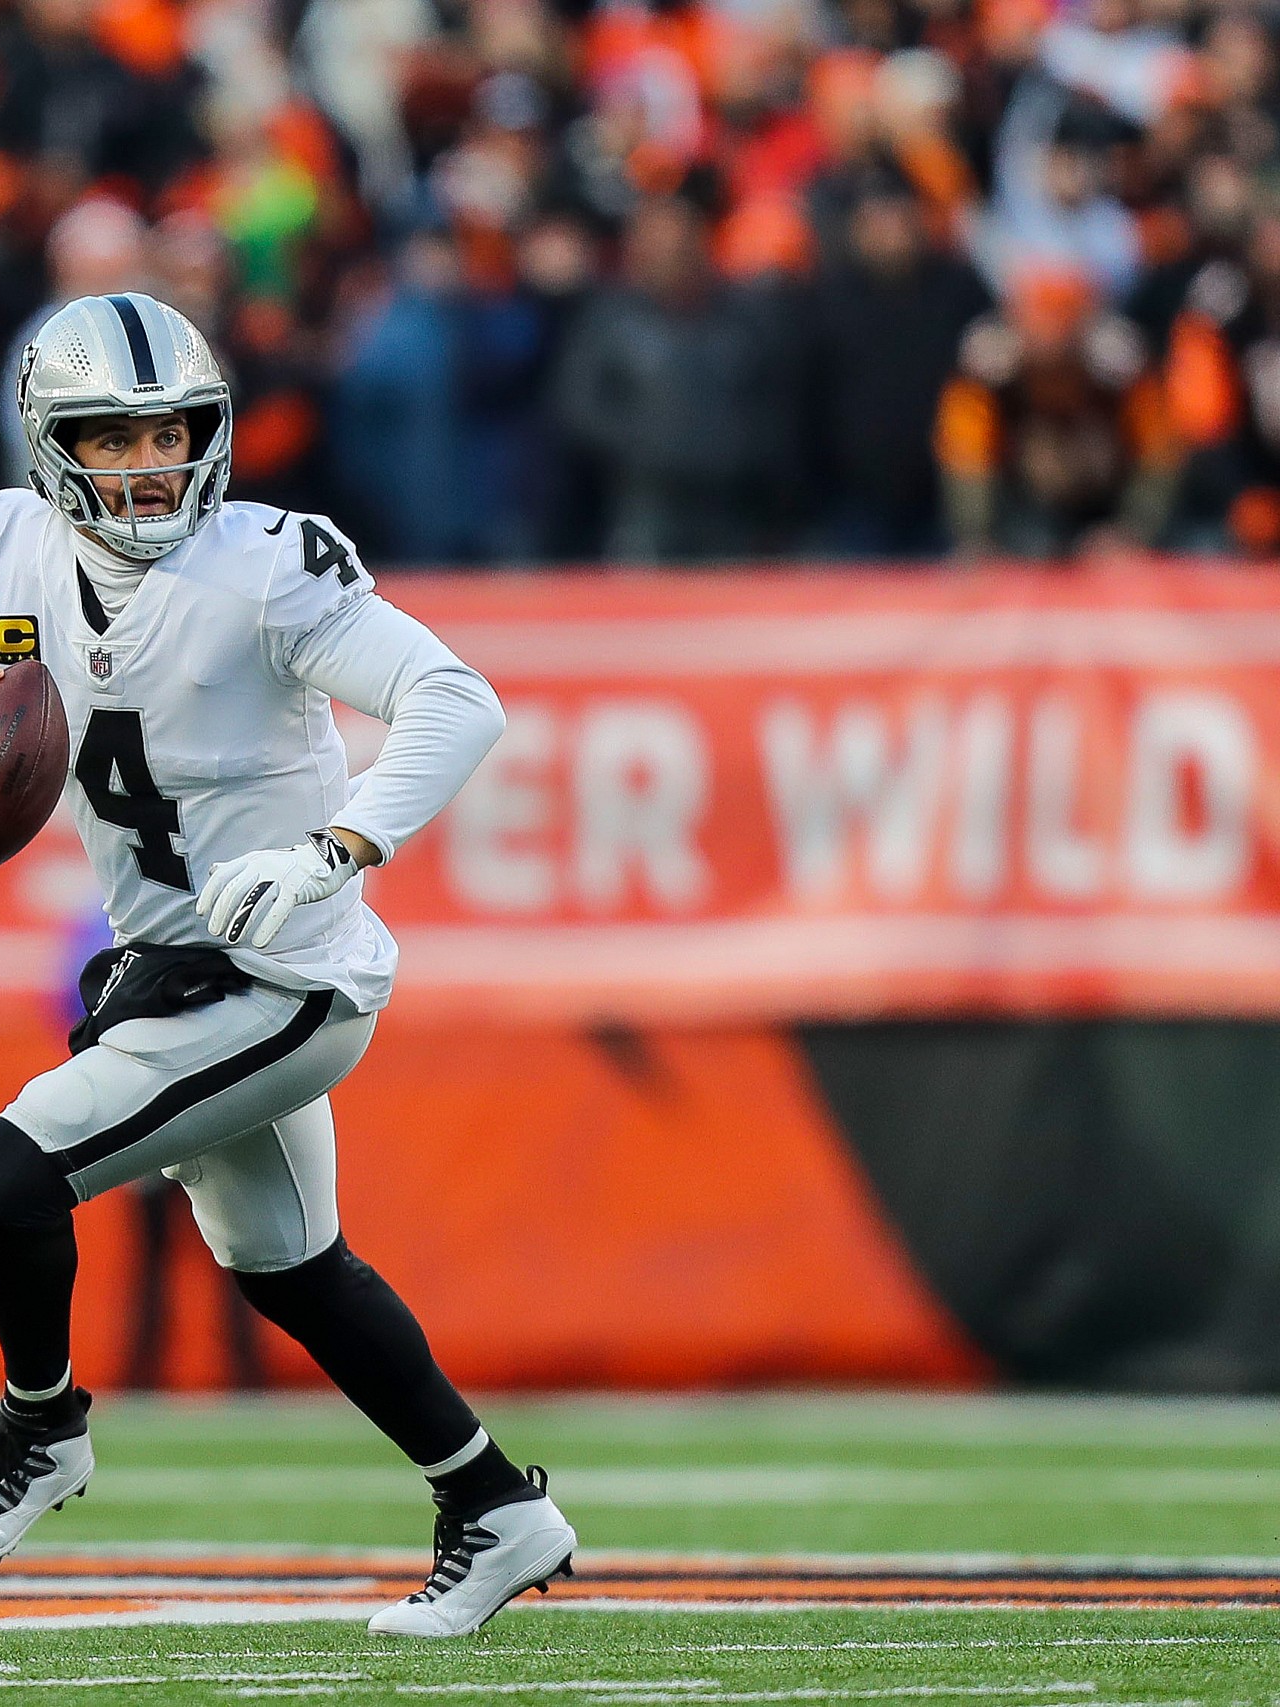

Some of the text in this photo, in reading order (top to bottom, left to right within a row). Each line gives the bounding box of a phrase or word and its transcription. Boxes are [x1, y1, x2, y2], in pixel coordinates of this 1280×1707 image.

[133, 385, 165, 394] RAIDERS
[299, 518, 360, 589] 4
[92, 660, 109, 675] NFL
[74, 706, 195, 893] 4
[750, 685, 1262, 908] WILD
